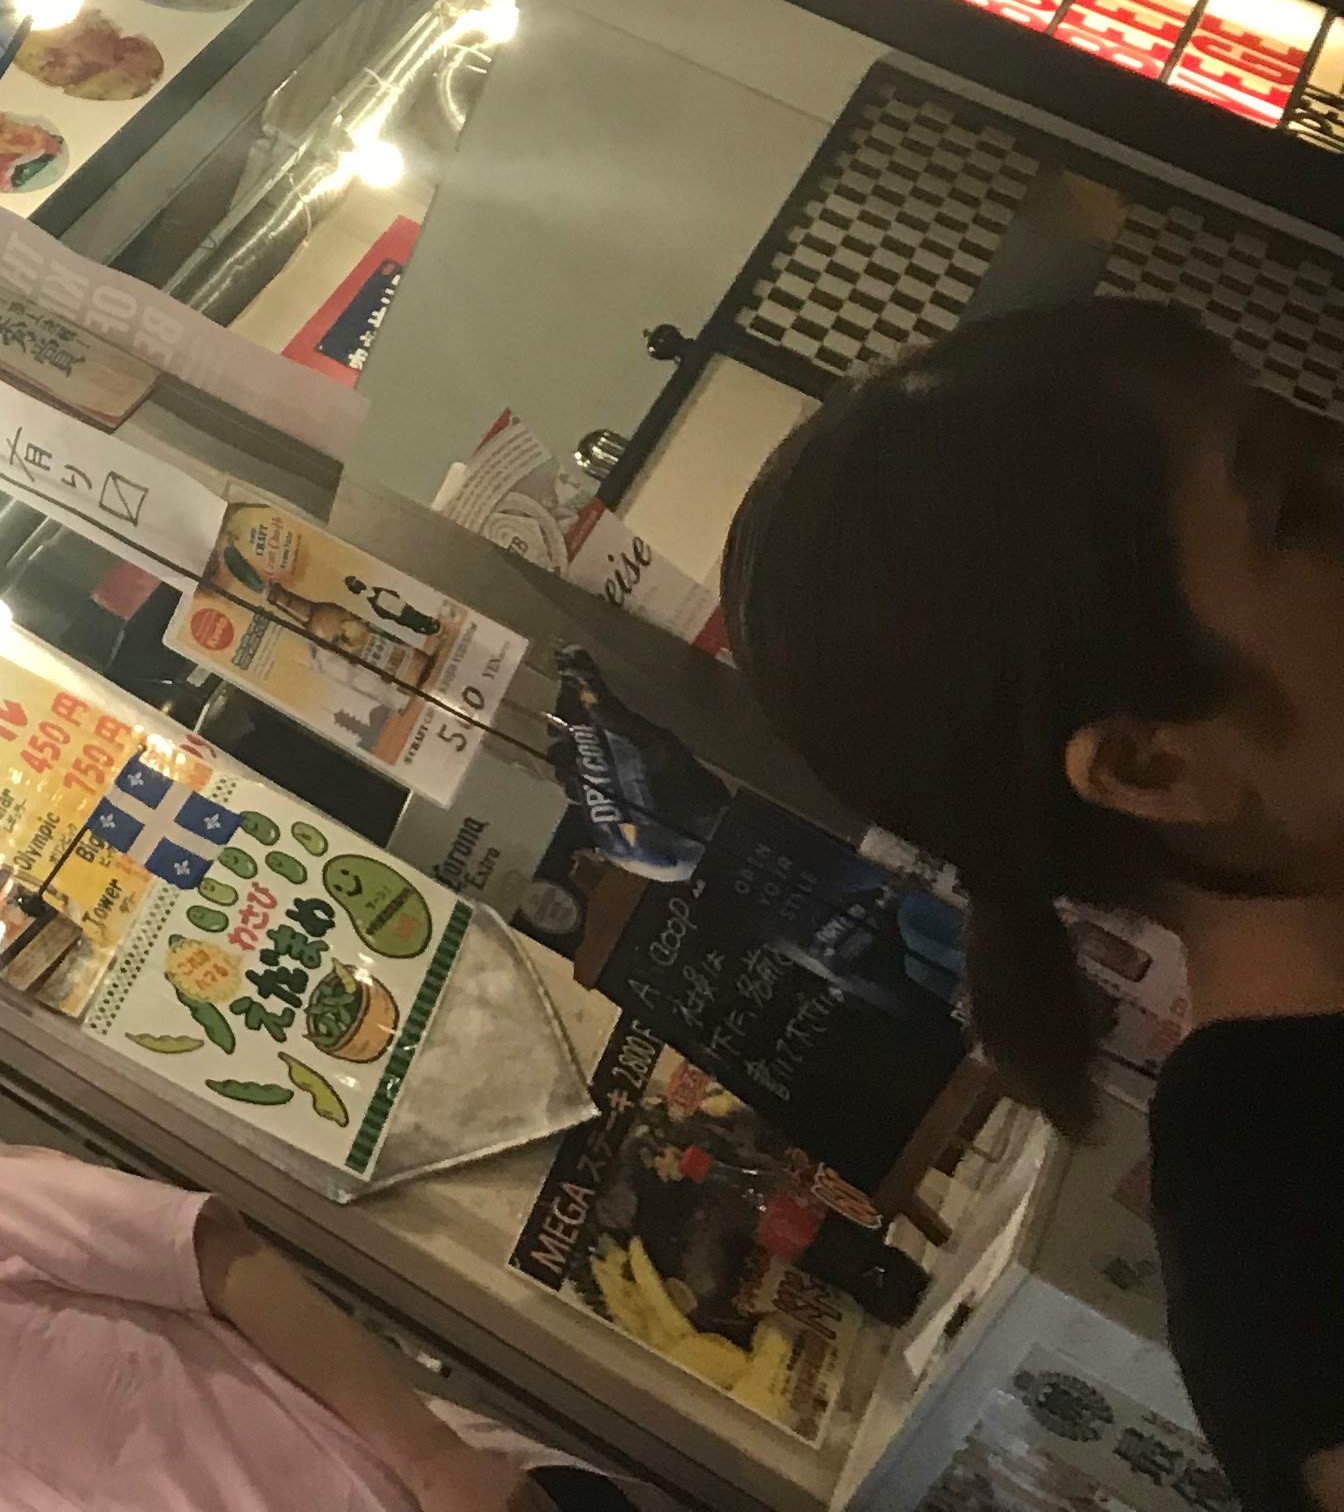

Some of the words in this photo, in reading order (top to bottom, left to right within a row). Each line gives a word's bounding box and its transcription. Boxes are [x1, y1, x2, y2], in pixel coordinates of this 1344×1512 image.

[1169, 14, 1307, 129] VEGE
[13, 810, 61, 874] Olympic
[431, 816, 489, 893] Corona
[465, 846, 502, 891] Extra
[82, 876, 124, 937] Tower
[228, 880, 278, 952] わさび
[229, 897, 336, 1043] えだまめ
[586, 1089, 637, 1186] ステーキ
[527, 1186, 594, 1275] MEGA
